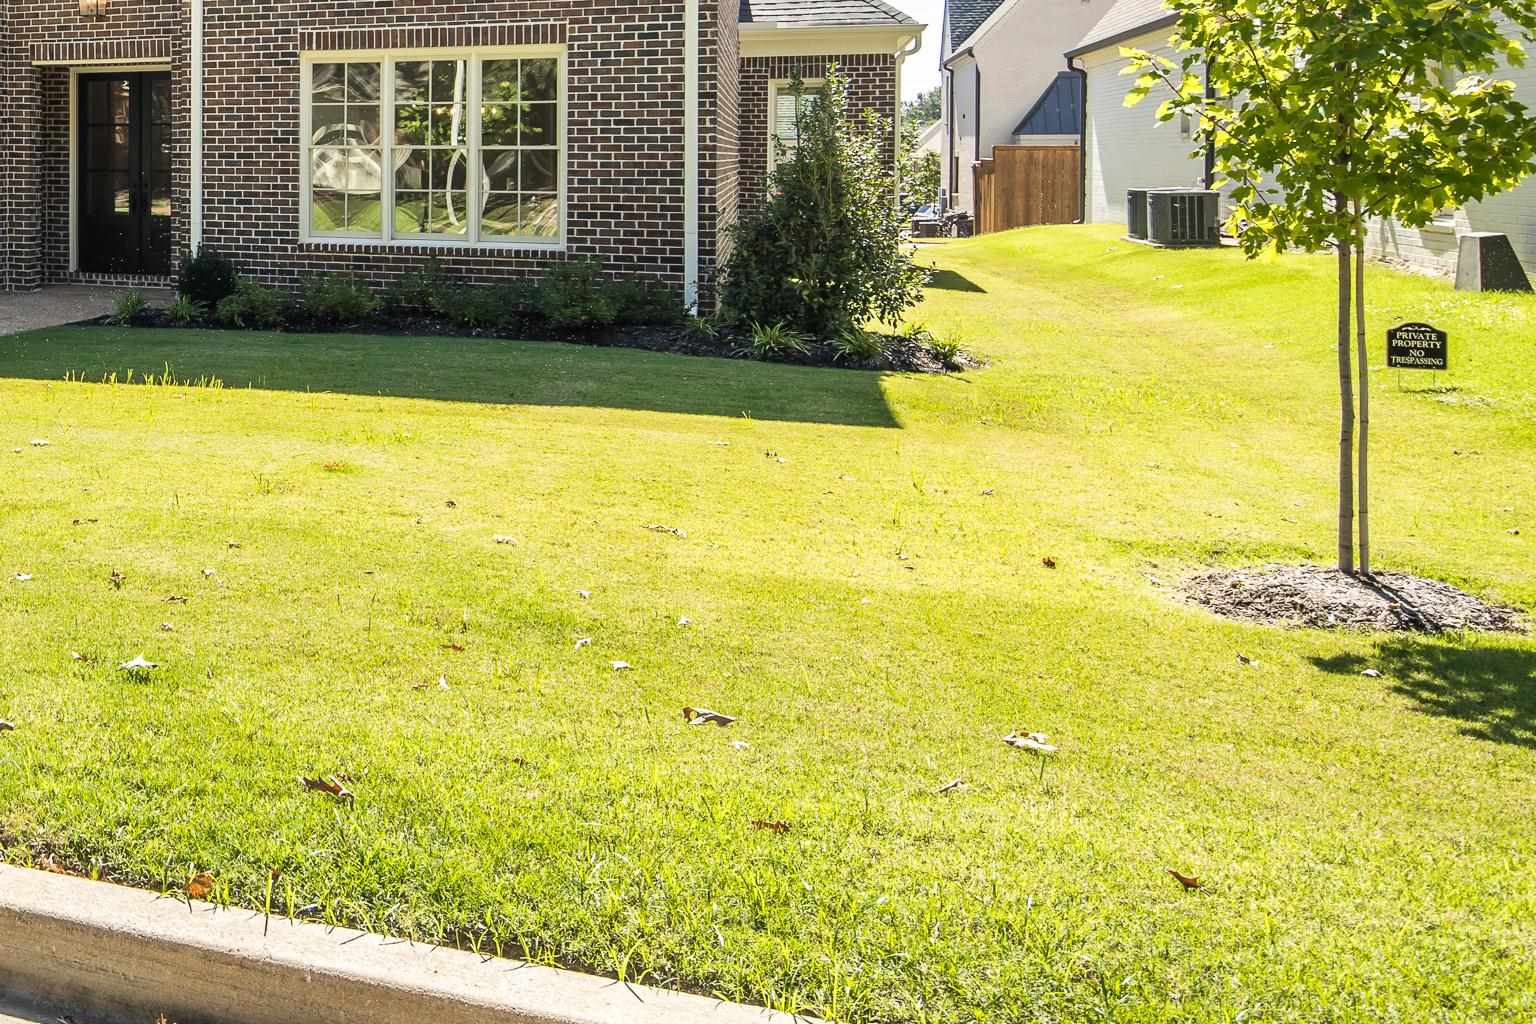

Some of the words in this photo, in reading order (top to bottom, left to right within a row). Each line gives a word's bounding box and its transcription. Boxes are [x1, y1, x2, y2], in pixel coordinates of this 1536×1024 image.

[1396, 332, 1438, 341] PRIVATE
[1392, 339, 1441, 349] PROPERTY
[1409, 349, 1425, 357] NO
[1391, 356, 1443, 365] TRESPASSING
